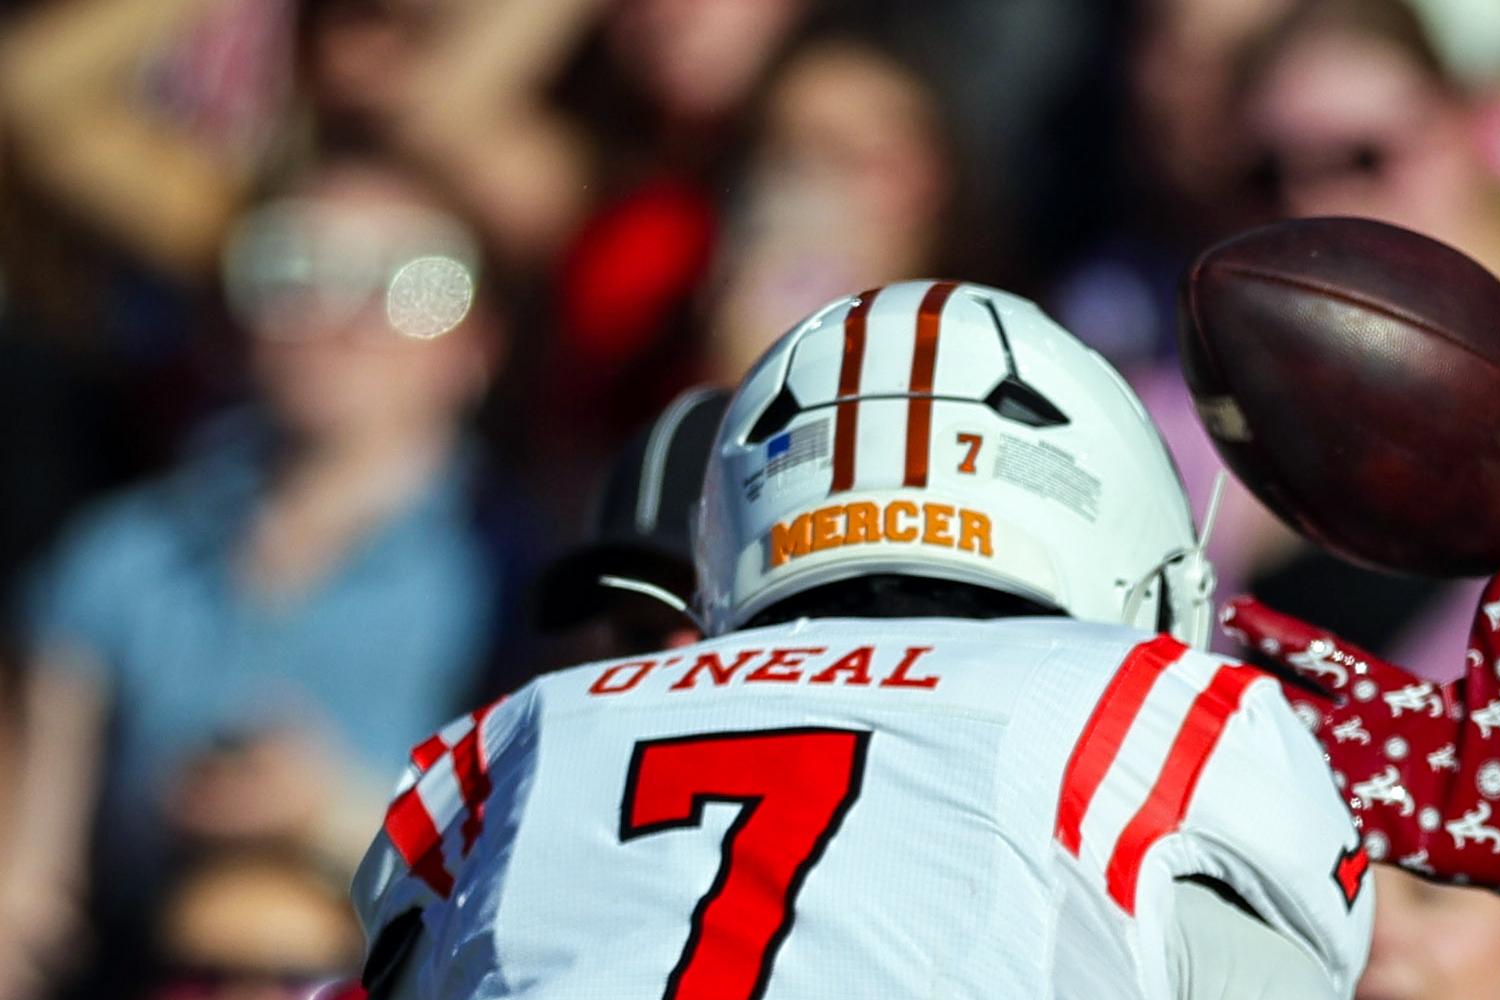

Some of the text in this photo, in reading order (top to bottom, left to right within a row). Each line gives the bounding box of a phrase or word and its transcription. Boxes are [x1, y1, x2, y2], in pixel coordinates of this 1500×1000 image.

[956, 432, 983, 475] 7
[769, 500, 993, 567] MERCER
[588, 646, 940, 695] O'NEAL
